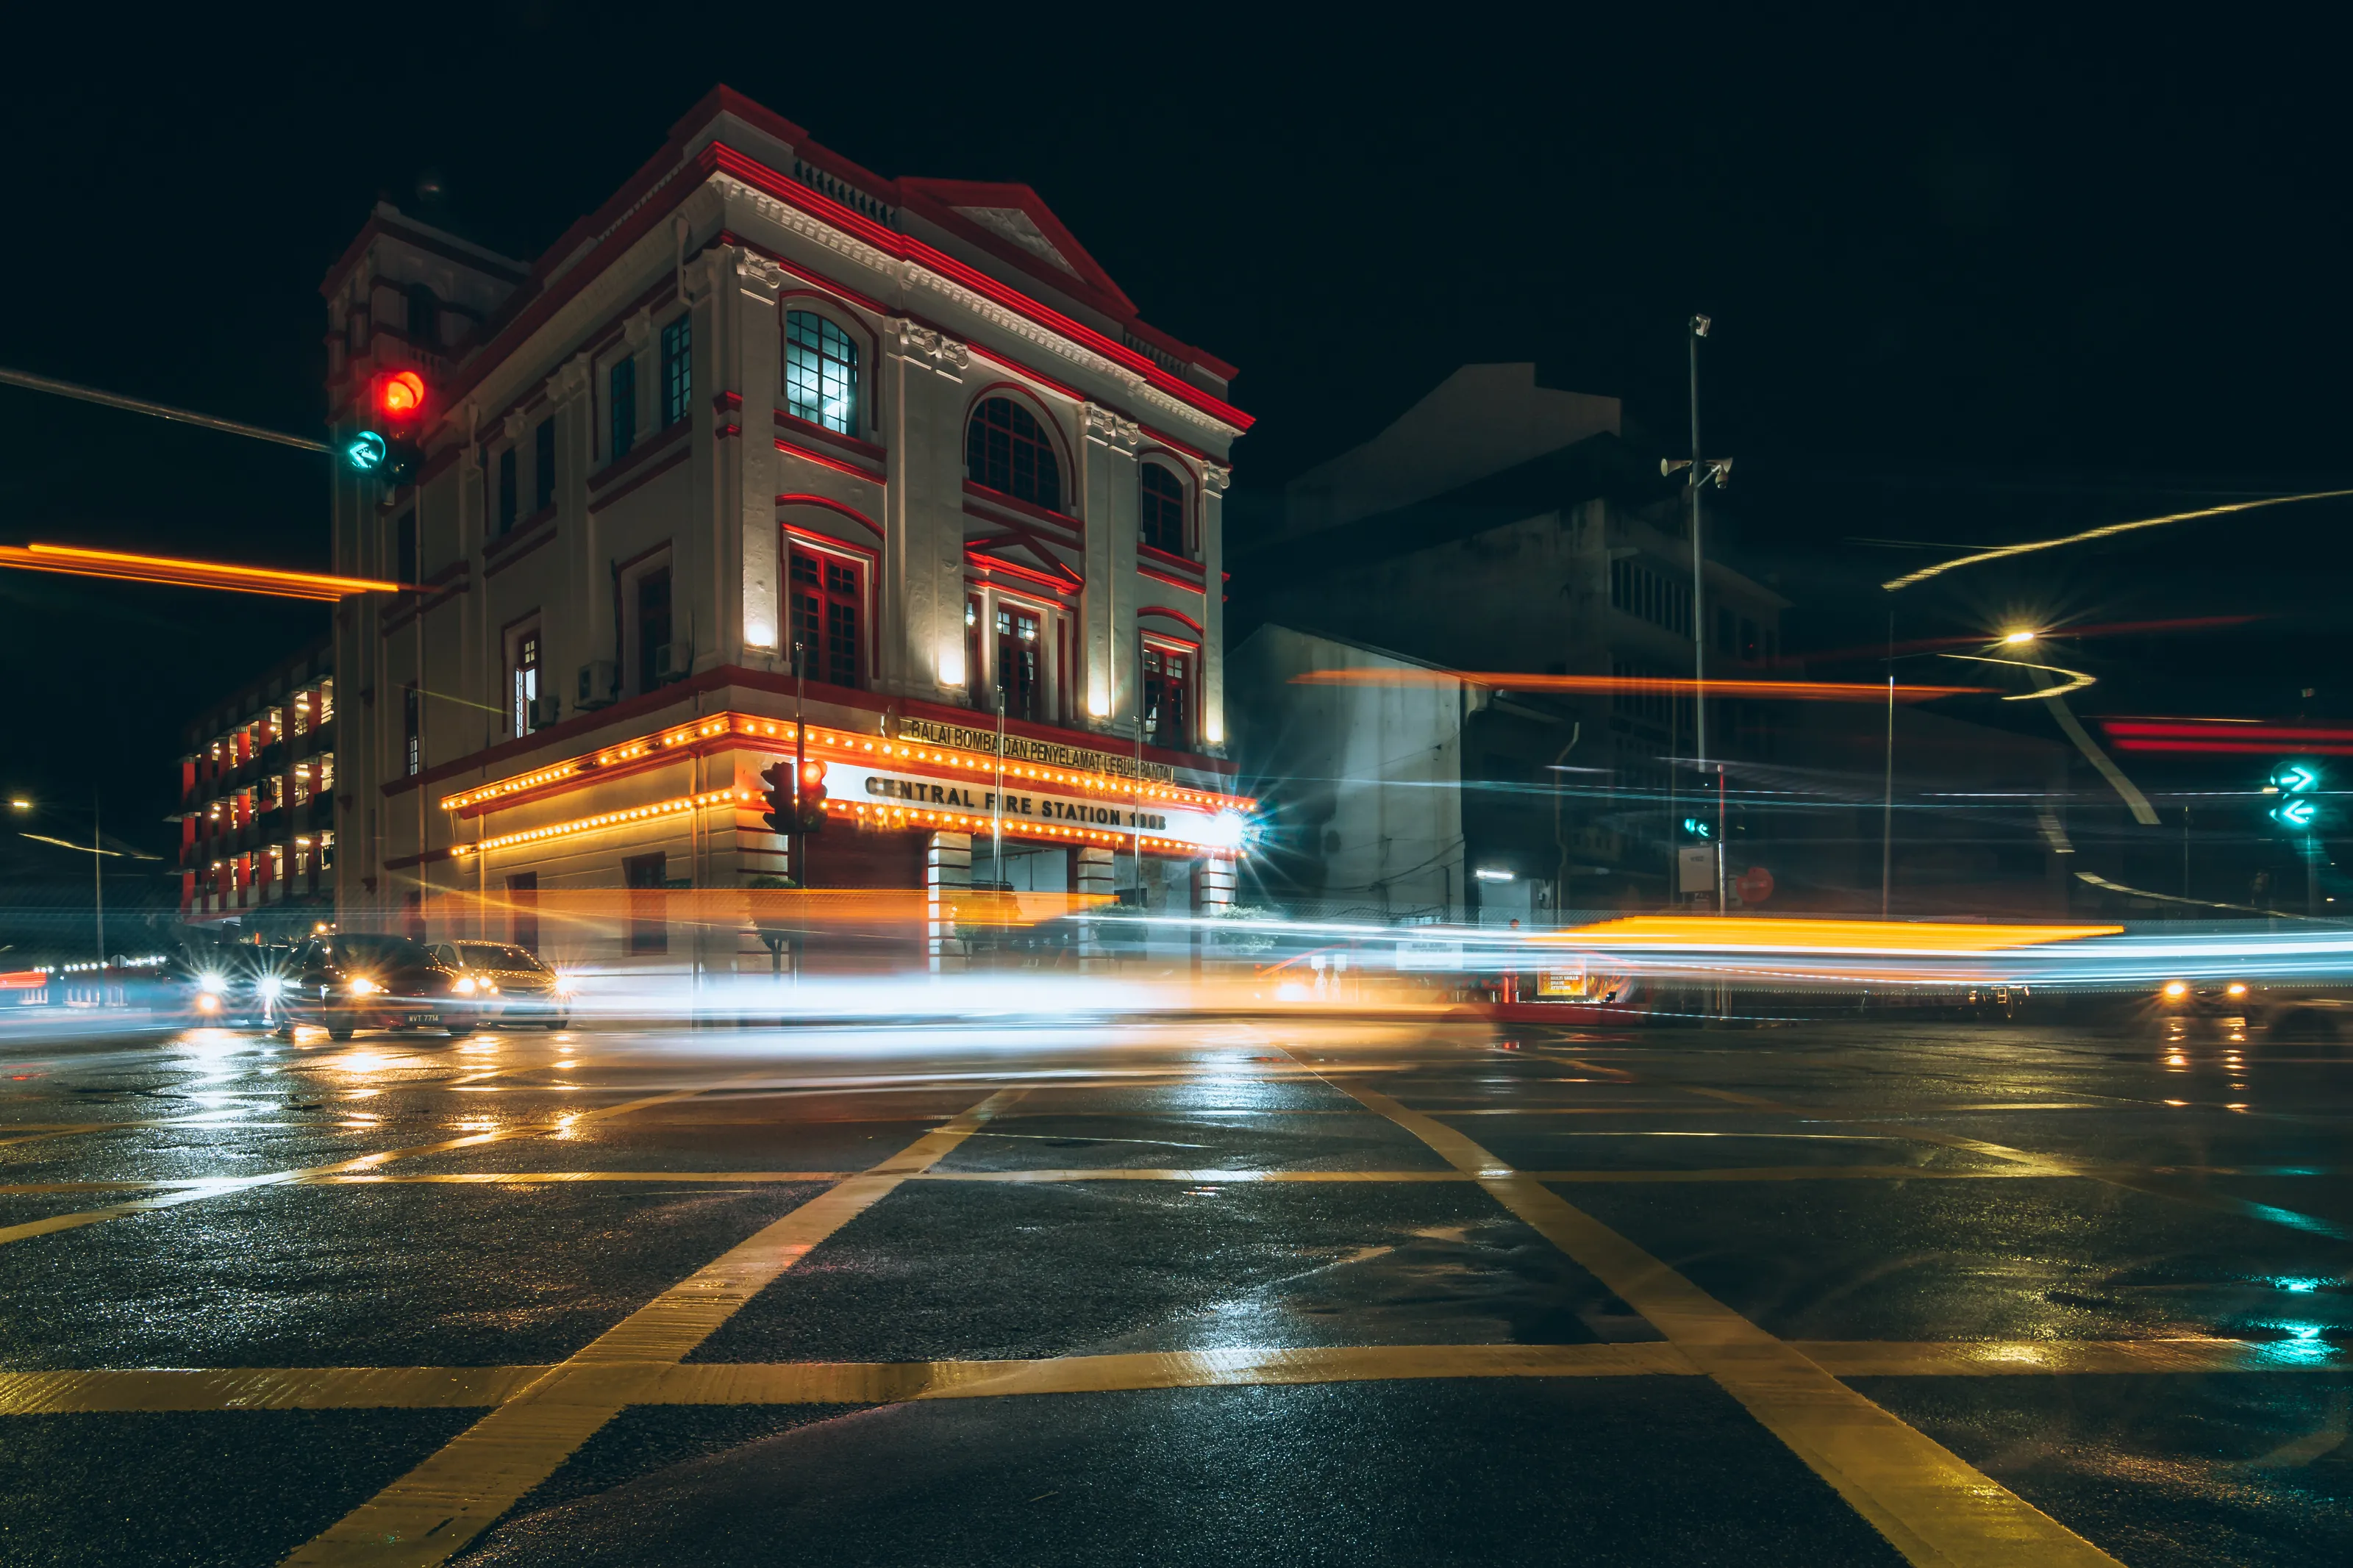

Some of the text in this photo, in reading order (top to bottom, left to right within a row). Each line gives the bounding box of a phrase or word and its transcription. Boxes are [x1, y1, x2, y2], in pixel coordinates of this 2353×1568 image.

[911, 720, 950, 745] BALAI
[954, 728, 999, 752] BOMBA
[1003, 737, 1026, 758] DAN
[1031, 742, 1101, 770] PENYELAMAT
[1140, 761, 1172, 782] PANTAI
[865, 776, 1166, 830] CENTRAL FIRE STATION 1908
